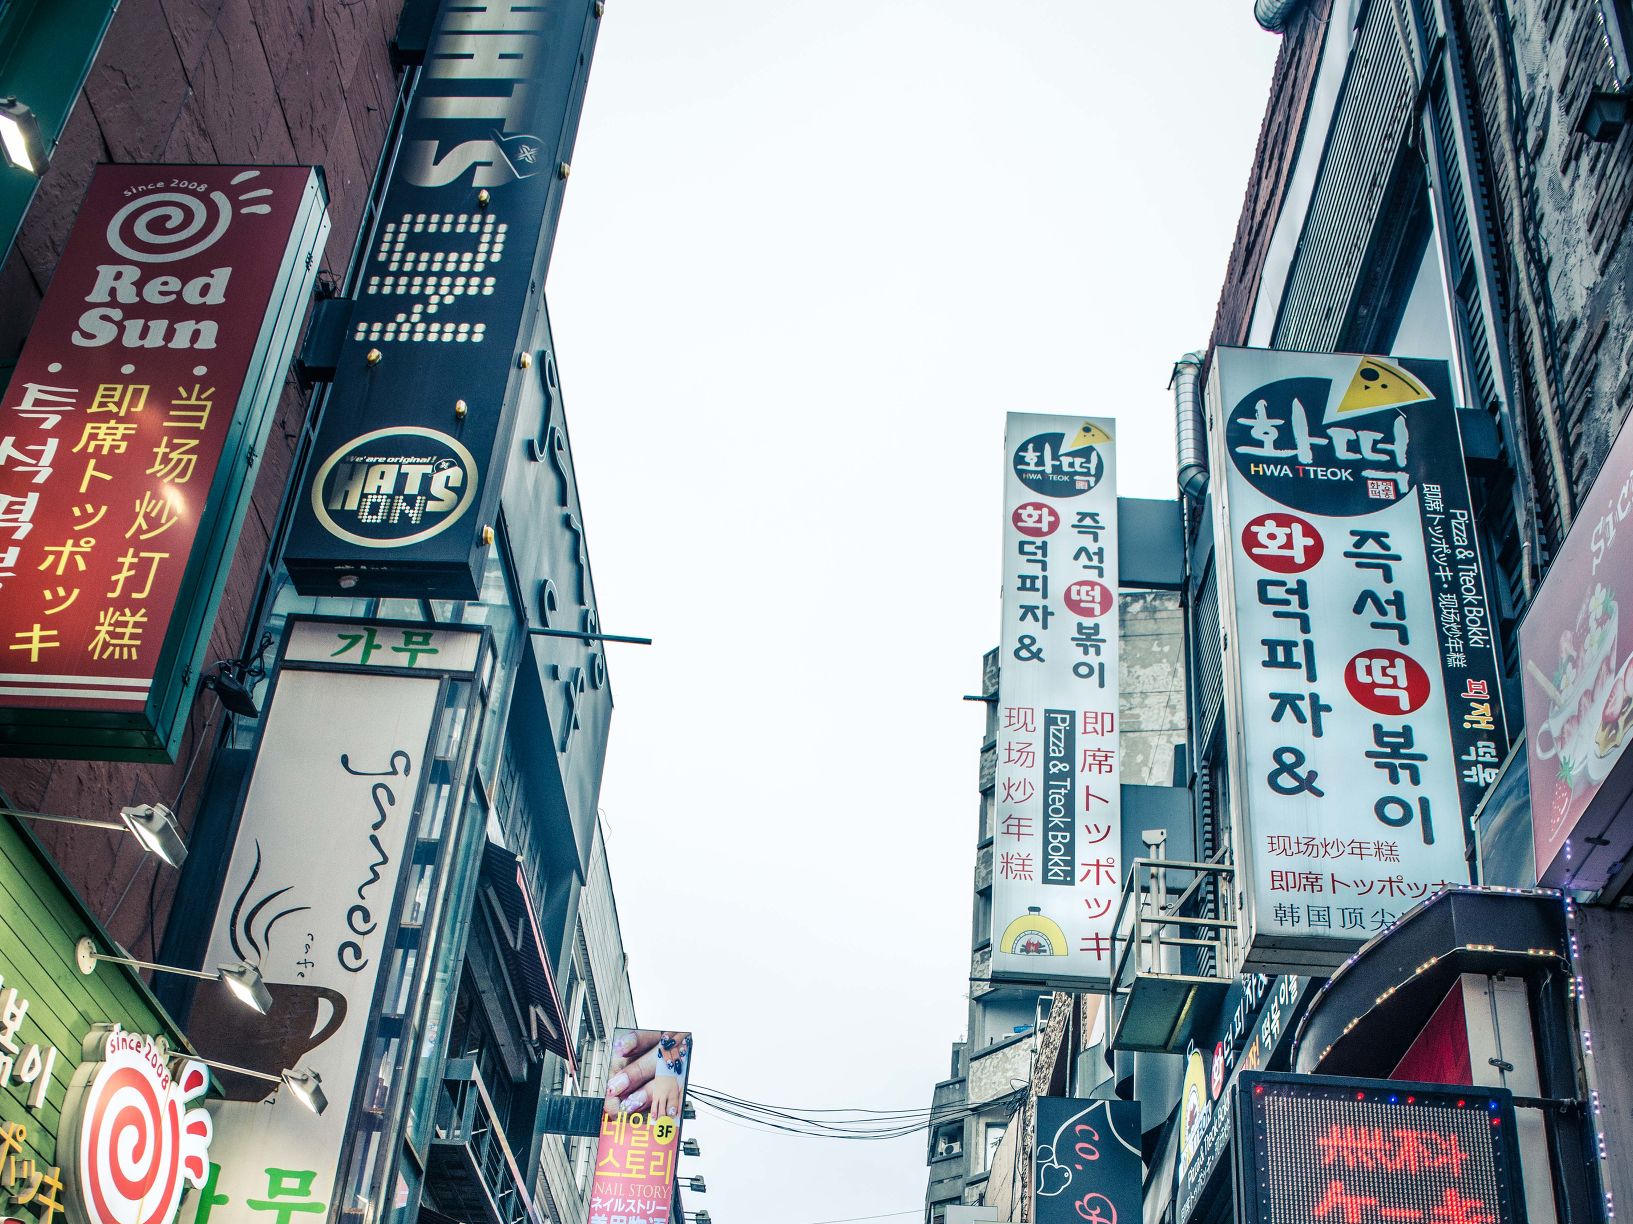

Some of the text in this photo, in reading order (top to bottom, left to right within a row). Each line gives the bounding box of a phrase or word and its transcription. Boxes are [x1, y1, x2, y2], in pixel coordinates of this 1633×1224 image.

[123, 179, 208, 197] since 2008
[84, 265, 232, 305] Red
[71, 307, 219, 349] Sun
[1017, 442, 1098, 488] 화떡
[1235, 397, 1411, 494] 화떡
[328, 458, 464, 513] HATS
[1250, 464, 1354, 482] HWA TTEOK
[9, 383, 151, 663] 即席トッポッキ
[88, 383, 216, 661] 当场炒打糕
[358, 494, 426, 524] ON
[1013, 505, 1055, 663] 화덕피자 &
[1449, 507, 1490, 649] Pizza & Tteok Bokki
[330, 626, 439, 668] 가무
[1250, 519, 1333, 798] 화덕피자 &
[999, 706, 1037, 882] 现场炒年糕
[1045, 712, 1072, 881] Pizza & Tteok Bokki
[1079, 711, 1117, 962] 即席トッポッキ
[1266, 835, 1402, 863] 现场炒年糕
[110, 1031, 169, 1091] since 2008
[602, 1112, 673, 1148] 네일 3F
[594, 1182, 670, 1199] NAIL STORY
[595, 1149, 674, 1185] 스토리
